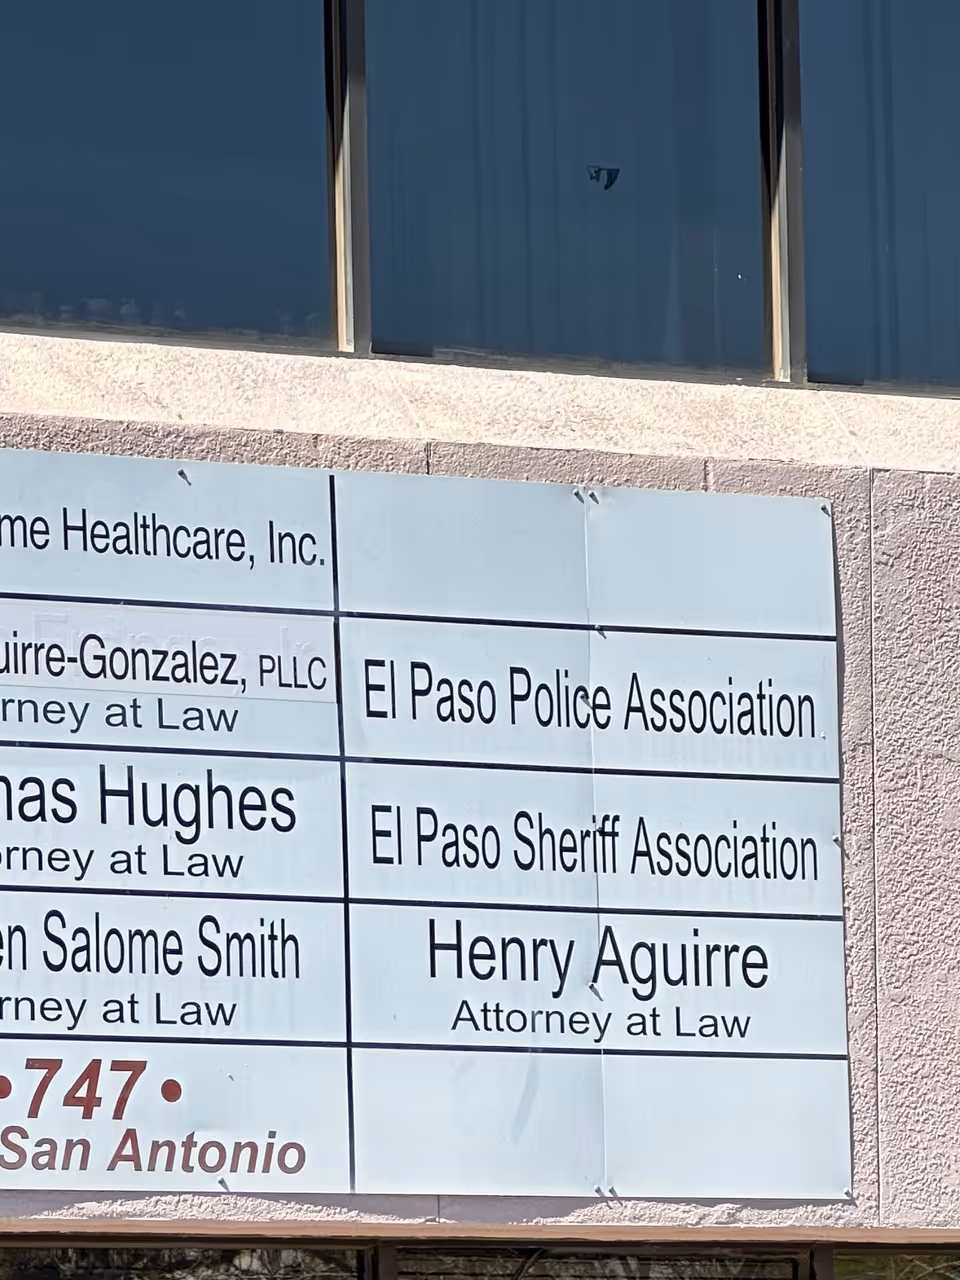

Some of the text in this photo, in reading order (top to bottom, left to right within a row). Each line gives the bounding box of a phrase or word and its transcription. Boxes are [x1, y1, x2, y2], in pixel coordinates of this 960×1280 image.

[63, 507, 254, 570] Healthcare,
[269, 520, 324, 565] Inc.
[259, 655, 326, 690] PLLC
[365, 659, 815, 738] El Paso Police Association
[106, 698, 142, 728] at
[158, 698, 238, 732] Law
[99, 764, 297, 845] Hughes
[110, 845, 147, 875] at
[163, 844, 244, 878] Law
[372, 805, 817, 880] El Paso Sheriff Association
[43, 910, 183, 975] Salome
[198, 915, 299, 978] Smith
[429, 919, 768, 1001] Henry Aguirre
[103, 993, 139, 1023] at
[156, 993, 236, 1026] Law
[451, 1000, 751, 1043] Attorney at Law
[107, 1128, 307, 1175] Antonio
